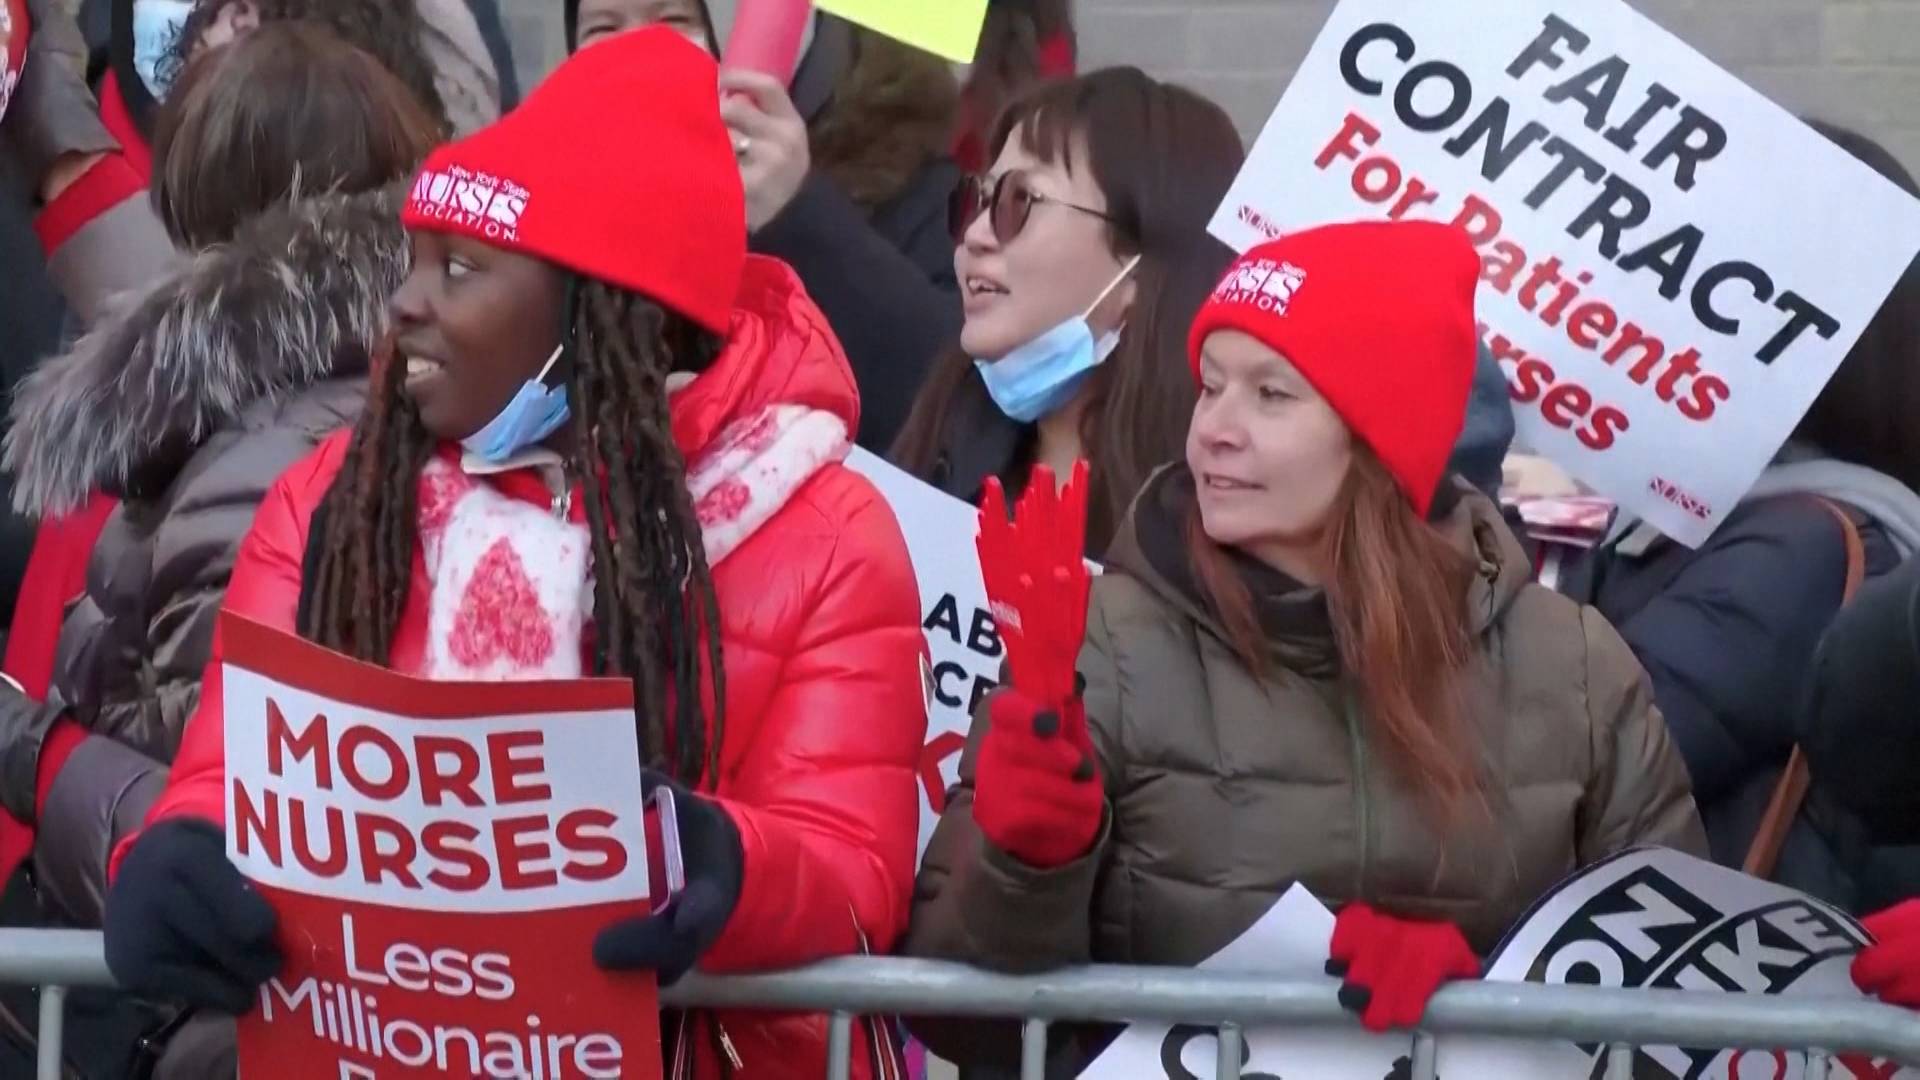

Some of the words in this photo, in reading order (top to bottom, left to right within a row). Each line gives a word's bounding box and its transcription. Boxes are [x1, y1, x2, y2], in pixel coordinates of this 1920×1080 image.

[1505, 13, 1728, 193] FAIR
[411, 171, 528, 229] NURSES
[1338, 22, 1841, 366] CONTRACT
[1313, 111, 1439, 222] For
[1450, 193, 1731, 422] Patients
[266, 696, 553, 807] MORE
[233, 777, 629, 892] NURSES
[342, 913, 516, 1001] Less
[259, 975, 624, 1080] Millionaire
